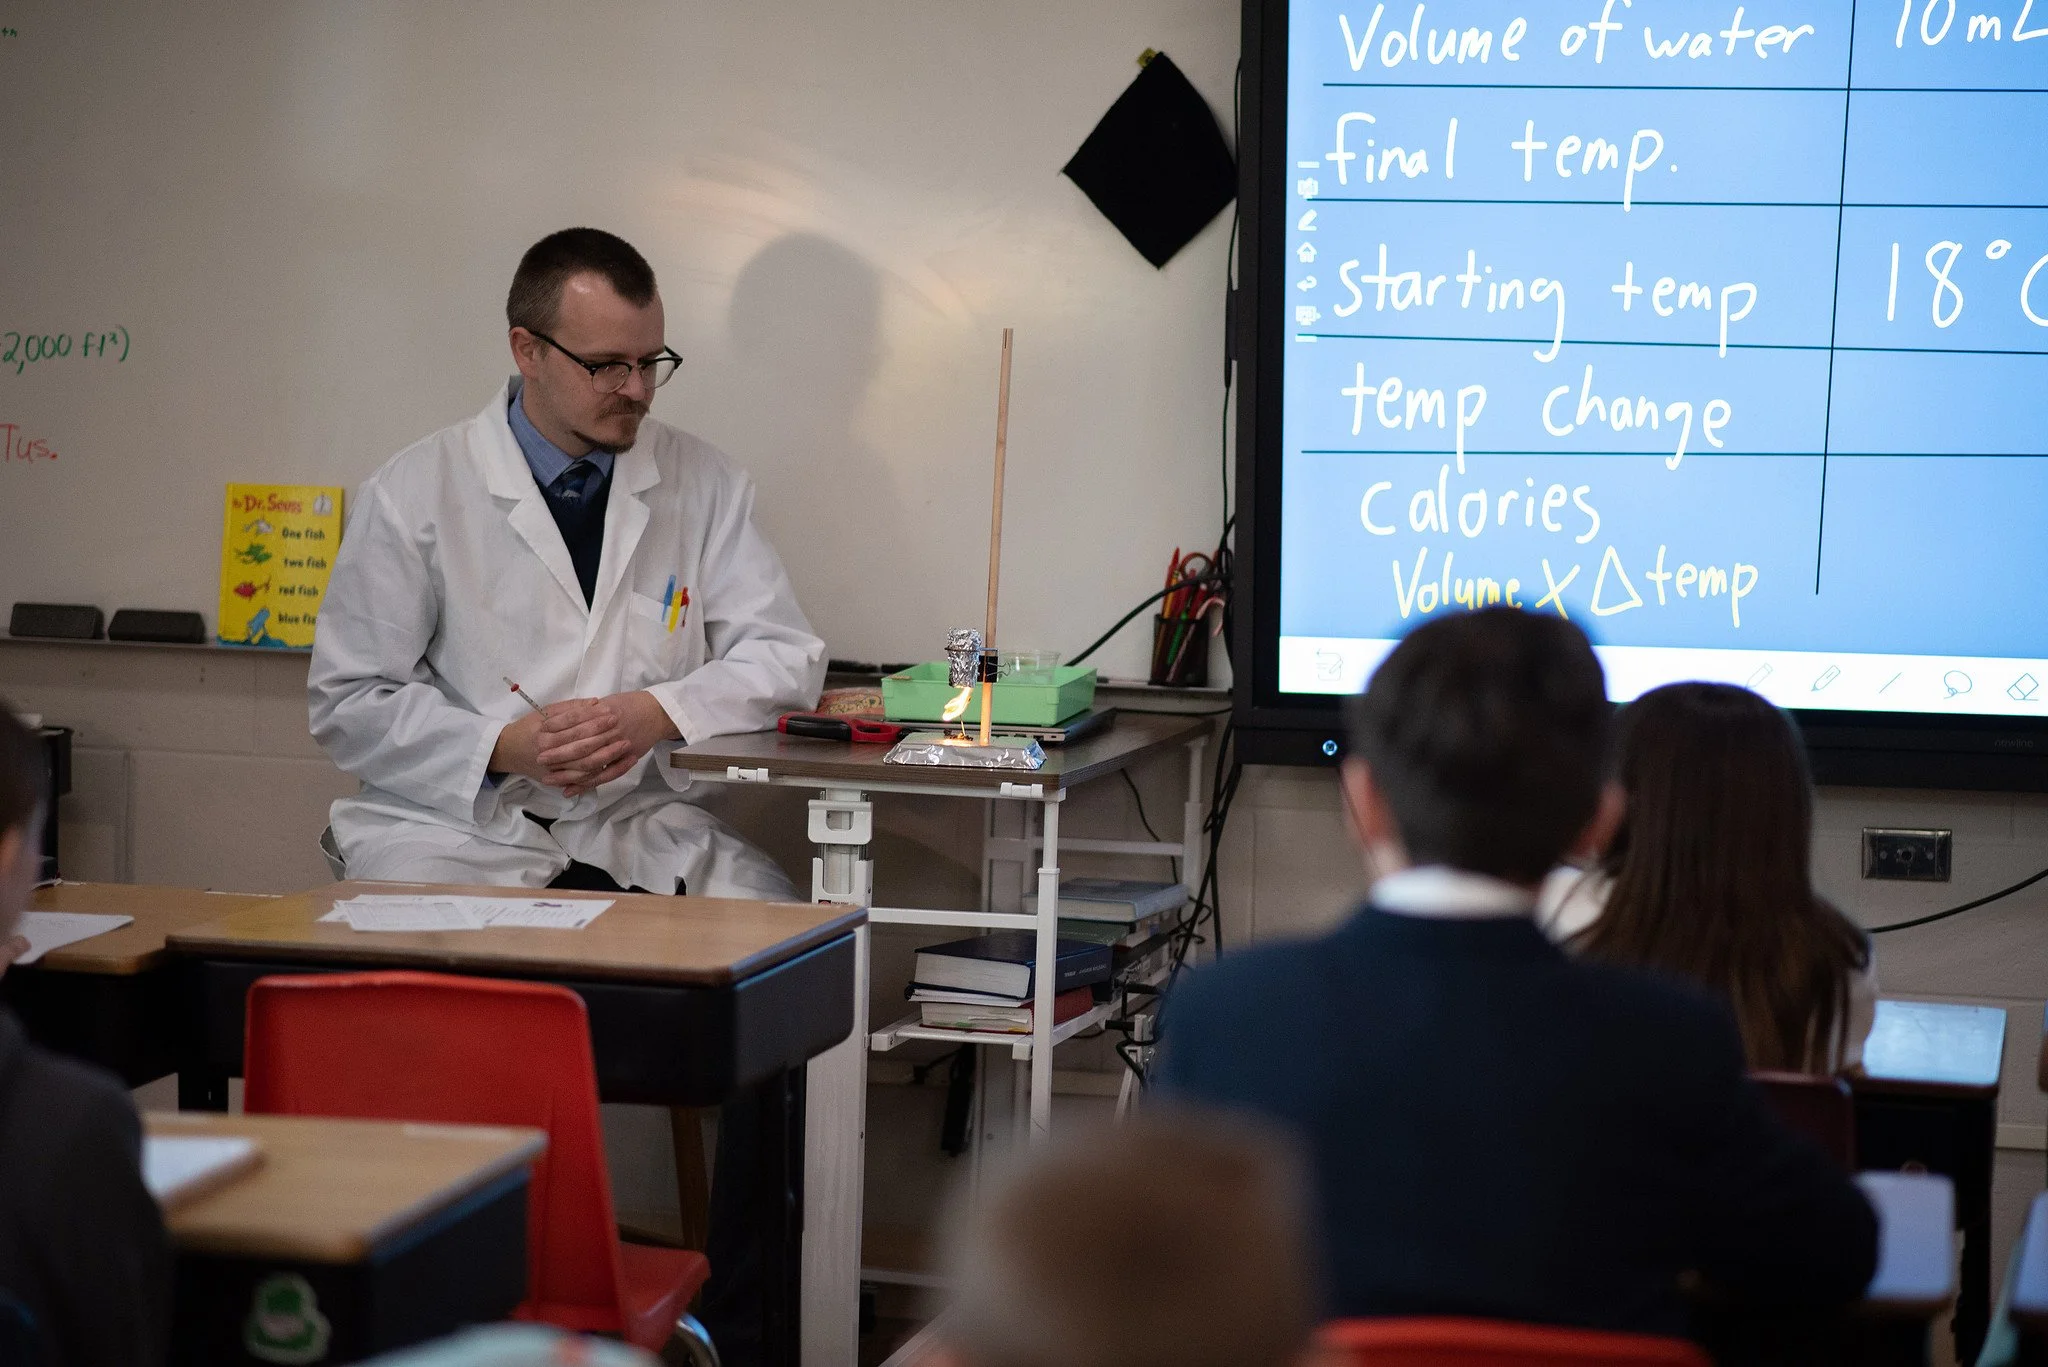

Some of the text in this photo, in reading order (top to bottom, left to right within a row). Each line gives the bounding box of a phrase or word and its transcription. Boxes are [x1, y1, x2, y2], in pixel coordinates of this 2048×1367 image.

[1339, 0, 1816, 72] Volume of water
[1895, 0, 2048, 49] 10 mL
[1325, 111, 1680, 213] final temp.
[1333, 243, 1759, 363] starting temp
[1341, 361, 1733, 475] temp change
[281, 527, 326, 540] One fish
[283, 556, 327, 570] two fish
[278, 584, 319, 597] red fish
[1393, 546, 1523, 620] Volume
[278, 613, 300, 625] blue
